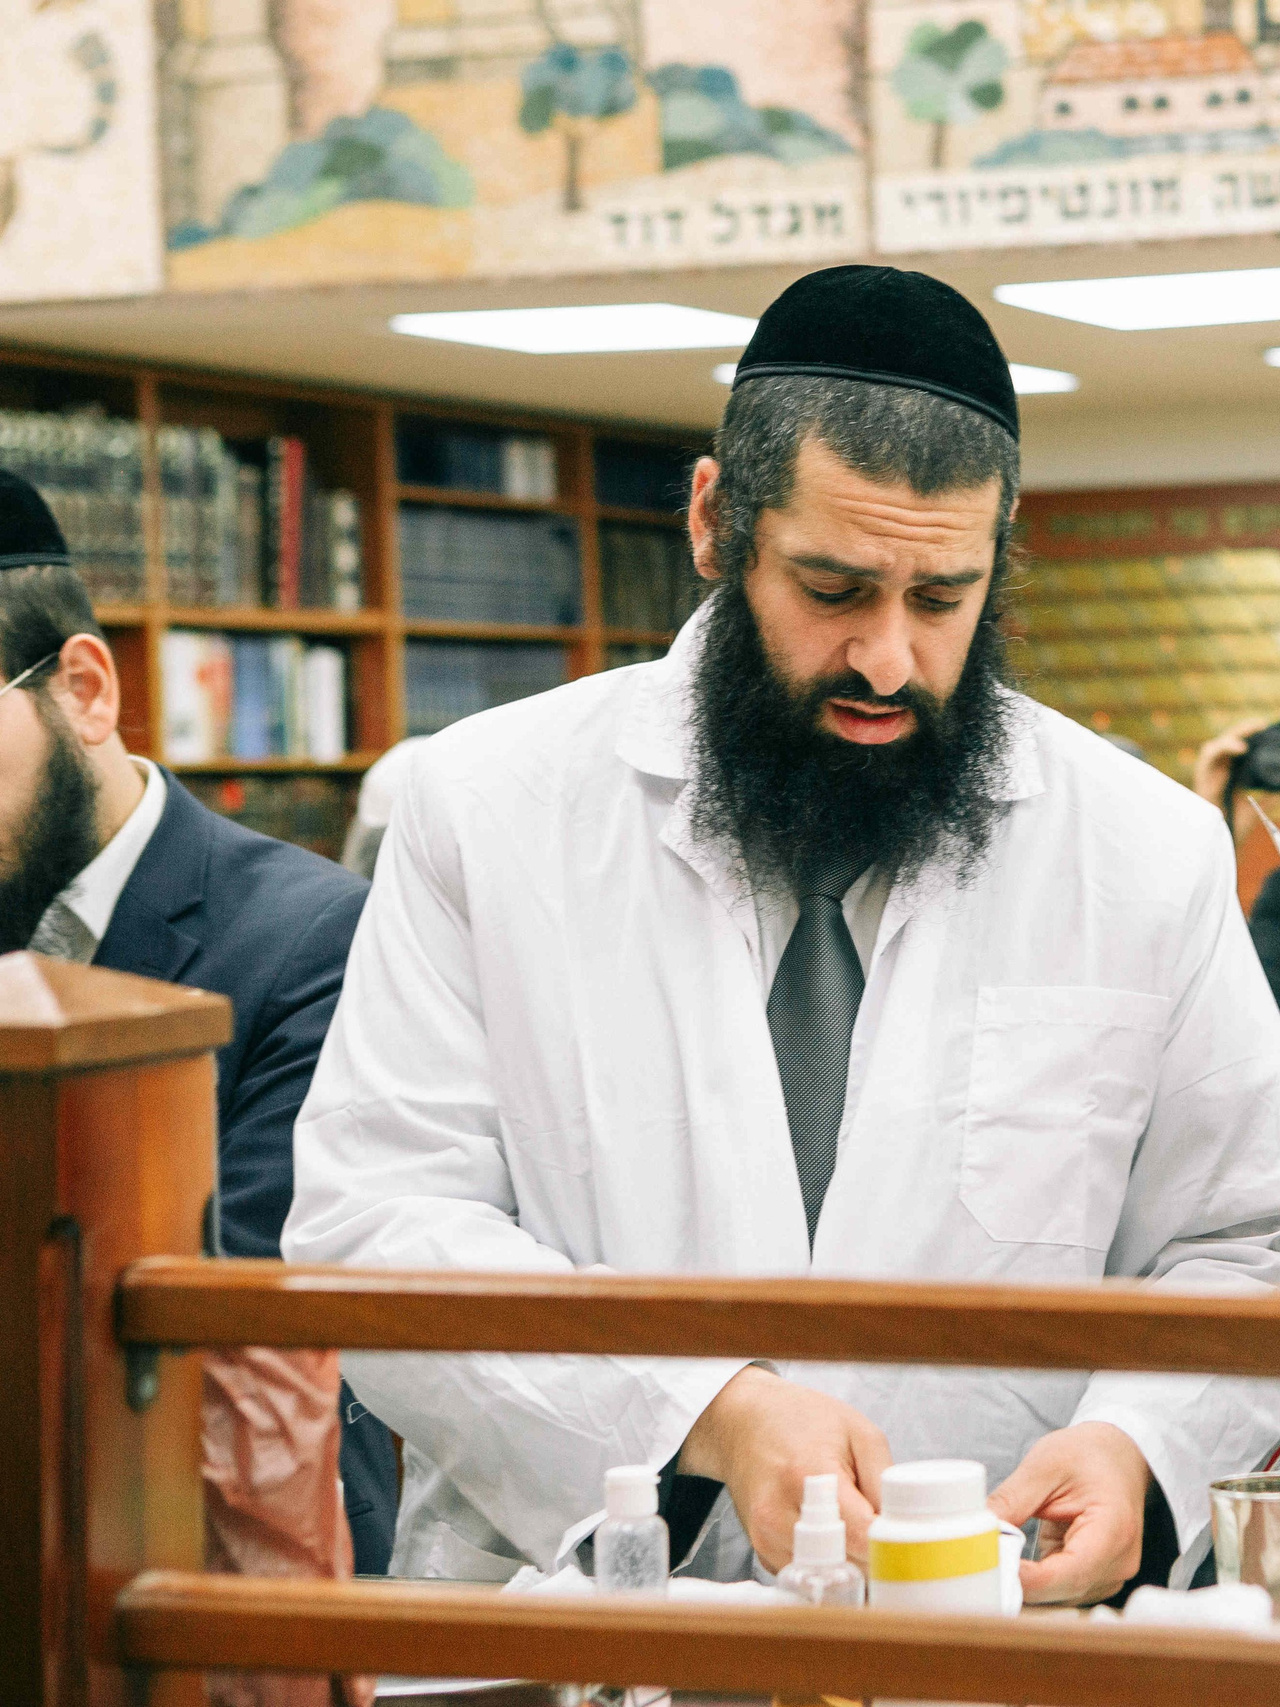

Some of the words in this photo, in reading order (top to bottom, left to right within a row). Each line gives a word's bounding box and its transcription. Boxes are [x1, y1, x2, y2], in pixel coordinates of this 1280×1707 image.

[708, 197, 845, 244] מגדל
[902, 174, 1184, 225] מונטיפיורי
[605, 206, 688, 248] דוד
